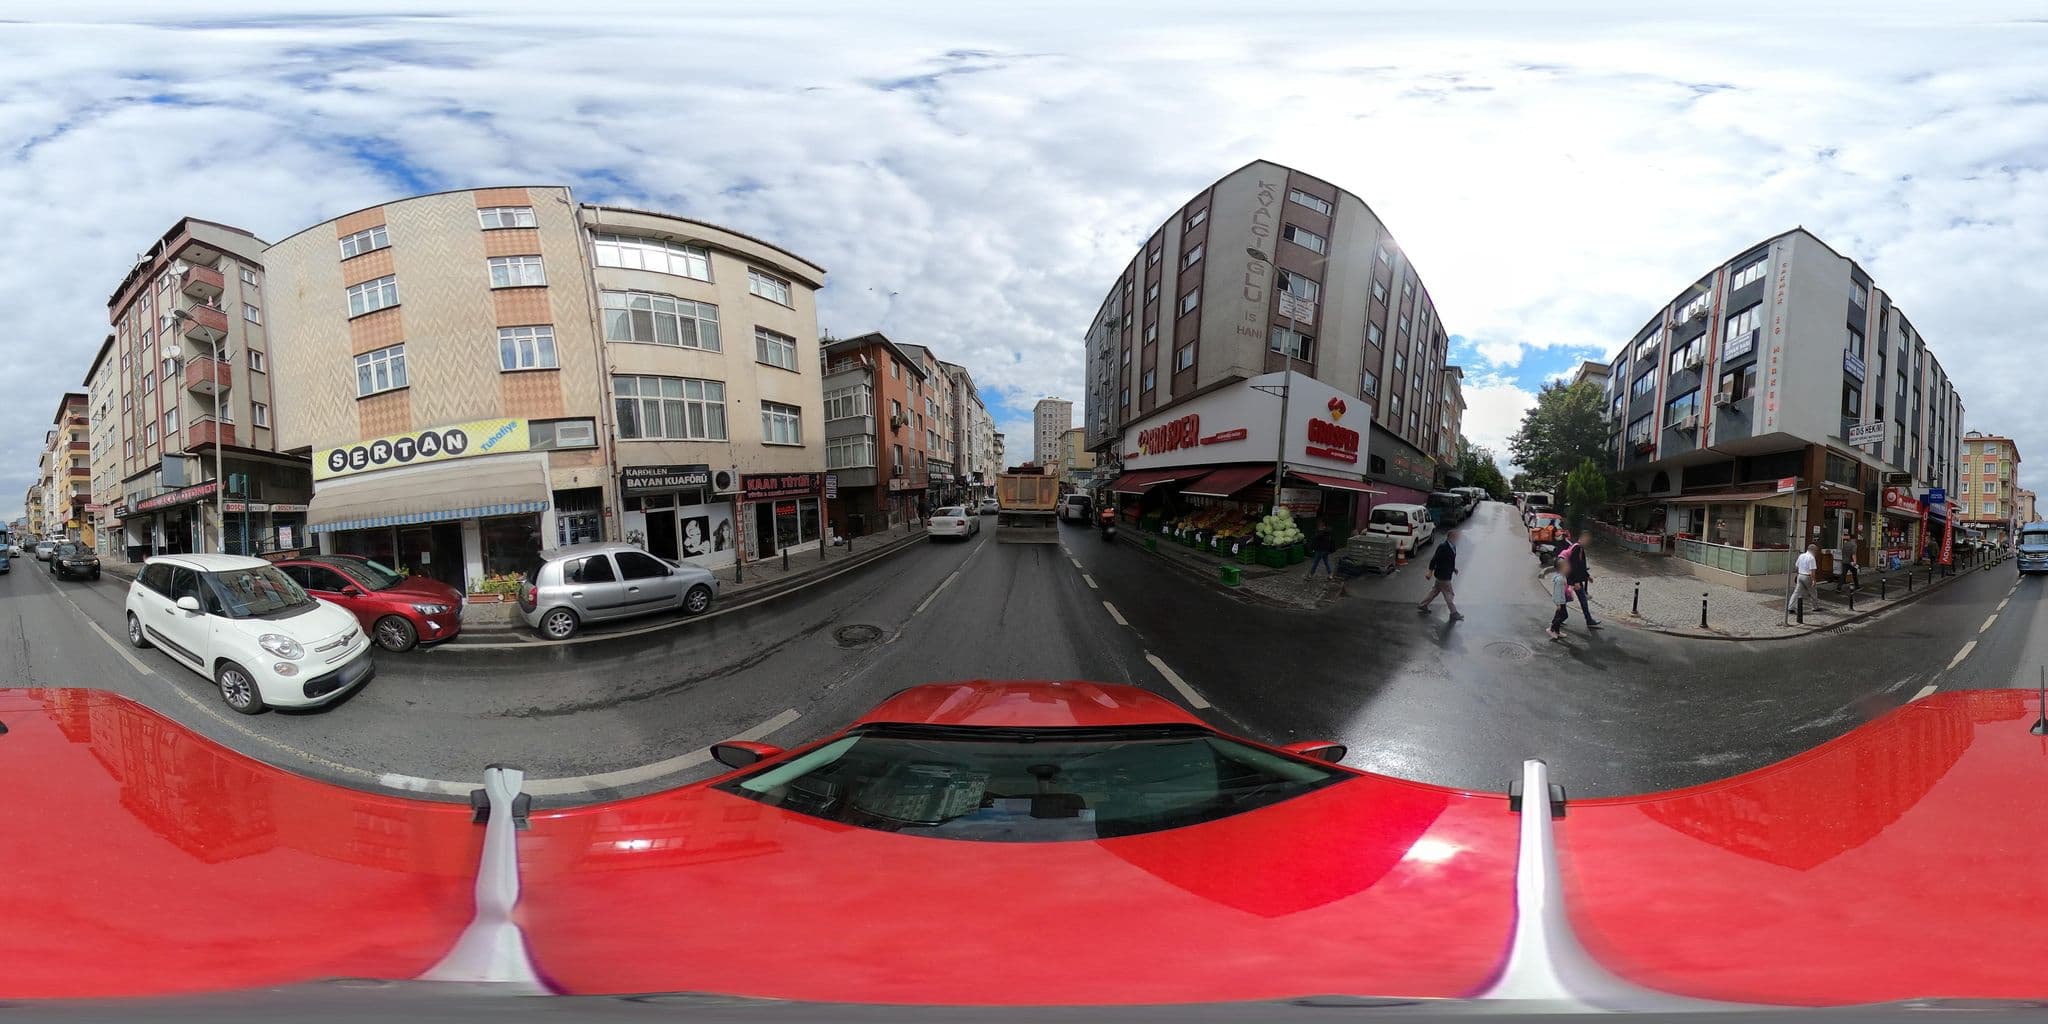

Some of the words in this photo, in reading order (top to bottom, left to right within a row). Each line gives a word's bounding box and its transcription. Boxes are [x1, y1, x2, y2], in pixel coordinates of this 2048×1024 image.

[480, 420, 518, 453] Tuhafiye
[330, 434, 465, 471] SERTAN
[181, 480, 226, 501] OTOMOTV
[627, 478, 663, 488] BAYAN
[665, 473, 708, 485] KUAFÖRÜ
